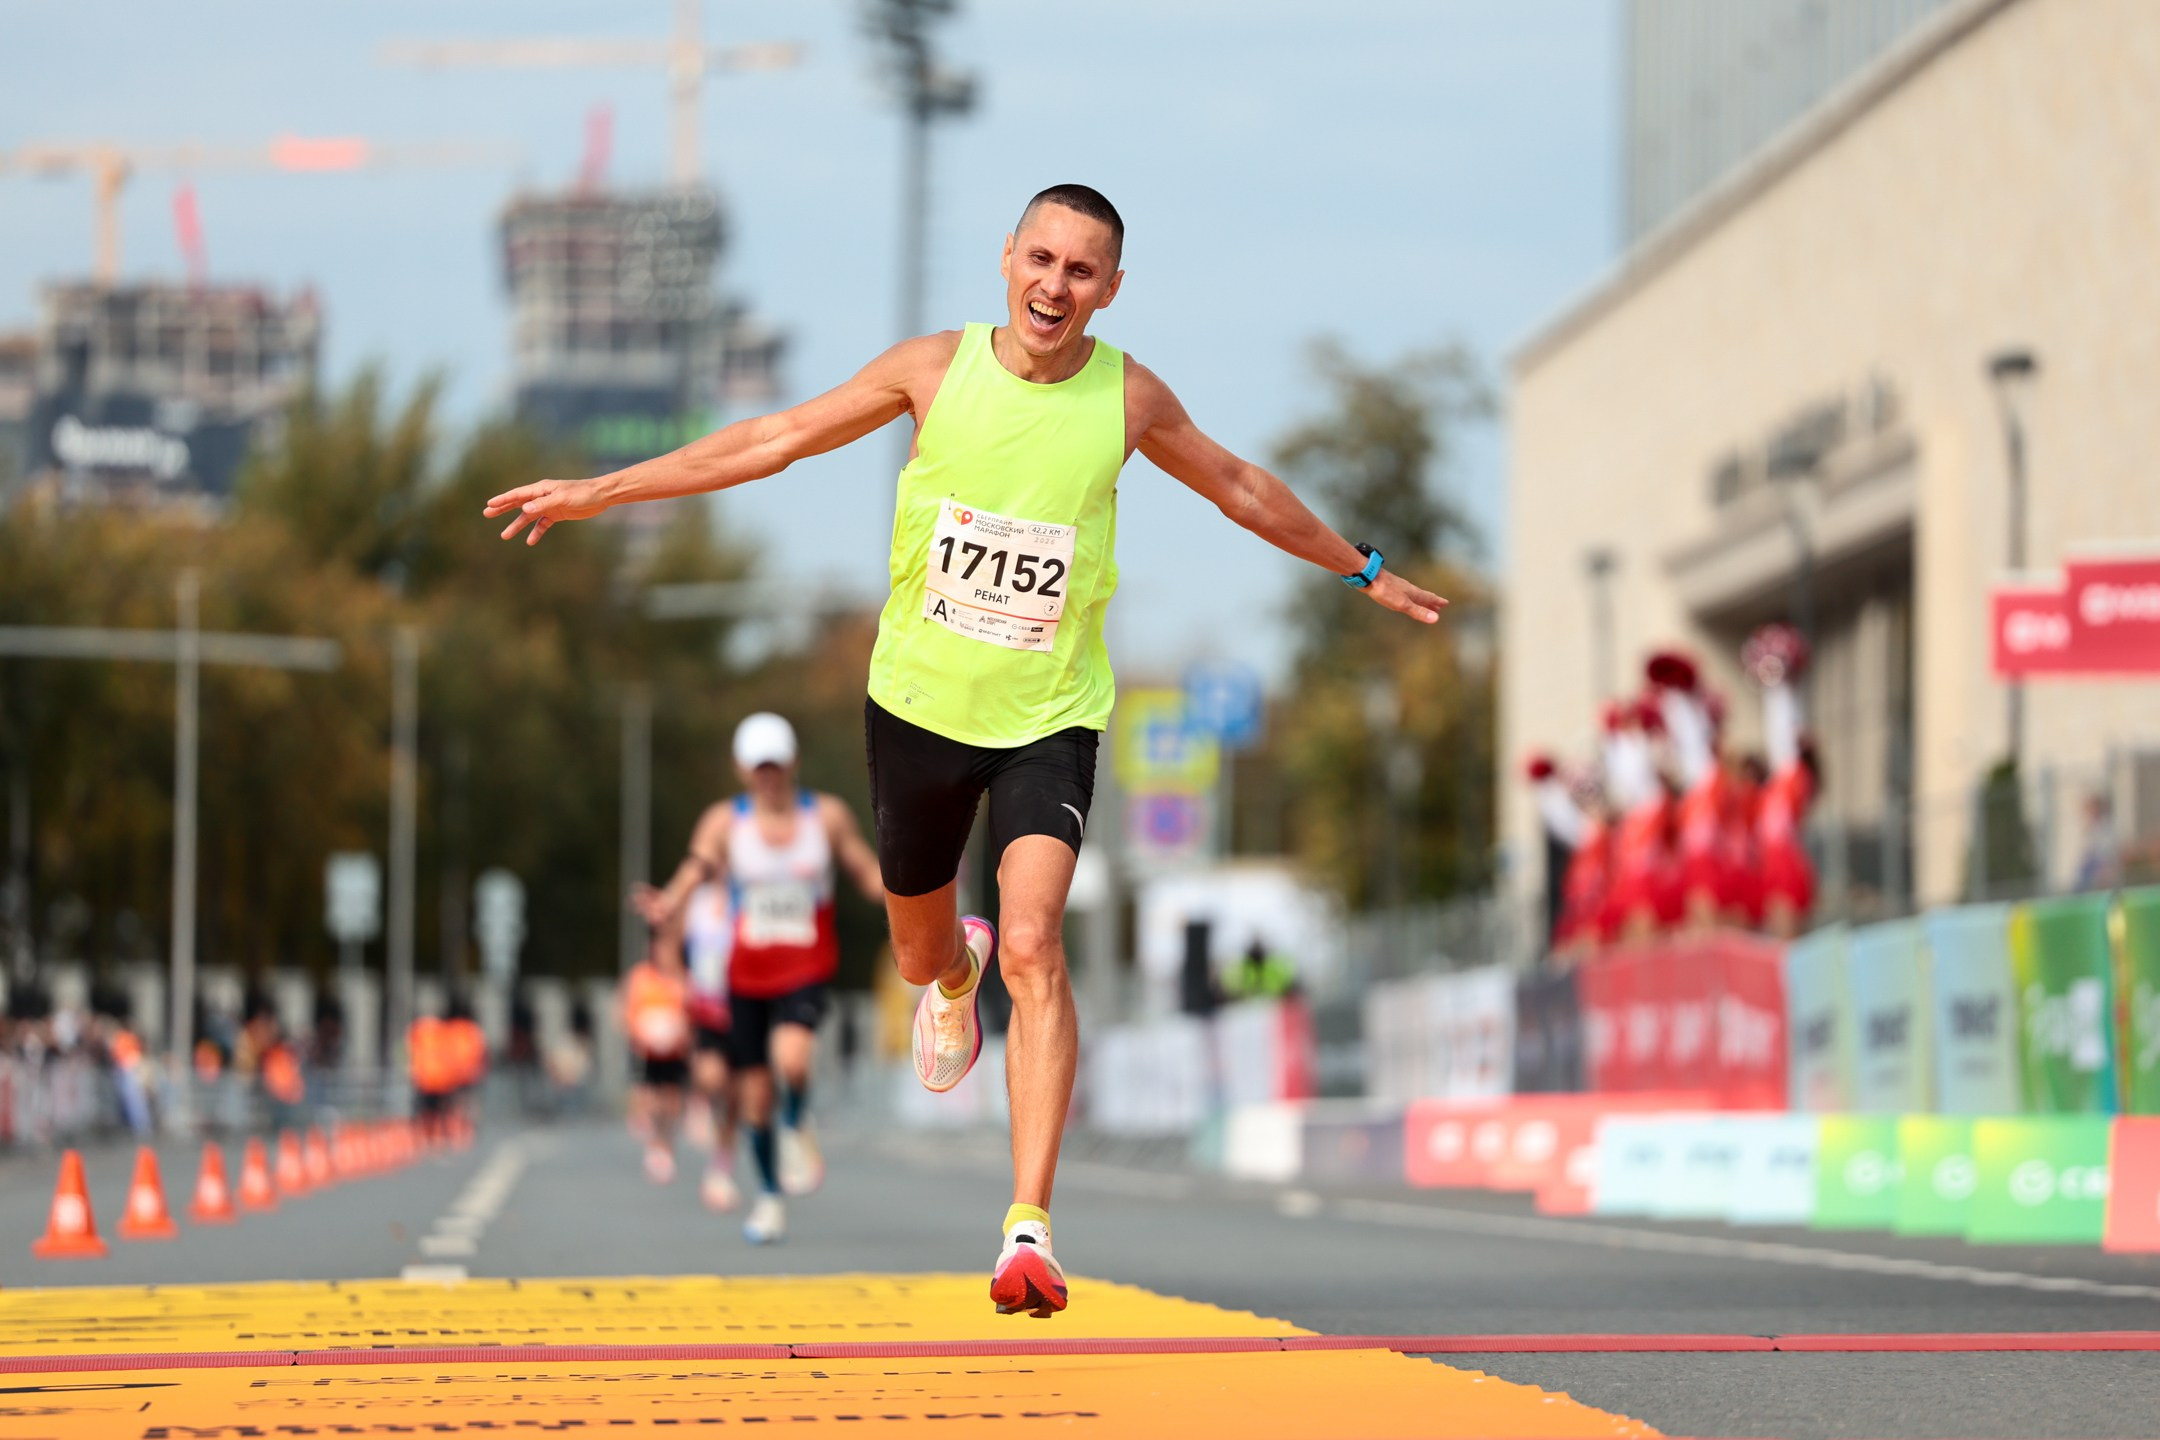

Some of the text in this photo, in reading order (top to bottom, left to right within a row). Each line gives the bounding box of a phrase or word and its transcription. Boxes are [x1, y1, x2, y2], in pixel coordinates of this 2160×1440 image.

[974, 525, 1011, 539] МАРАФОН
[975, 519, 1024, 535] МОСКОВСКИЙ
[1031, 526, 1048, 536] 42,2
[939, 535, 1065, 598] 17152
[974, 588, 1011, 605] РЕНАТ
